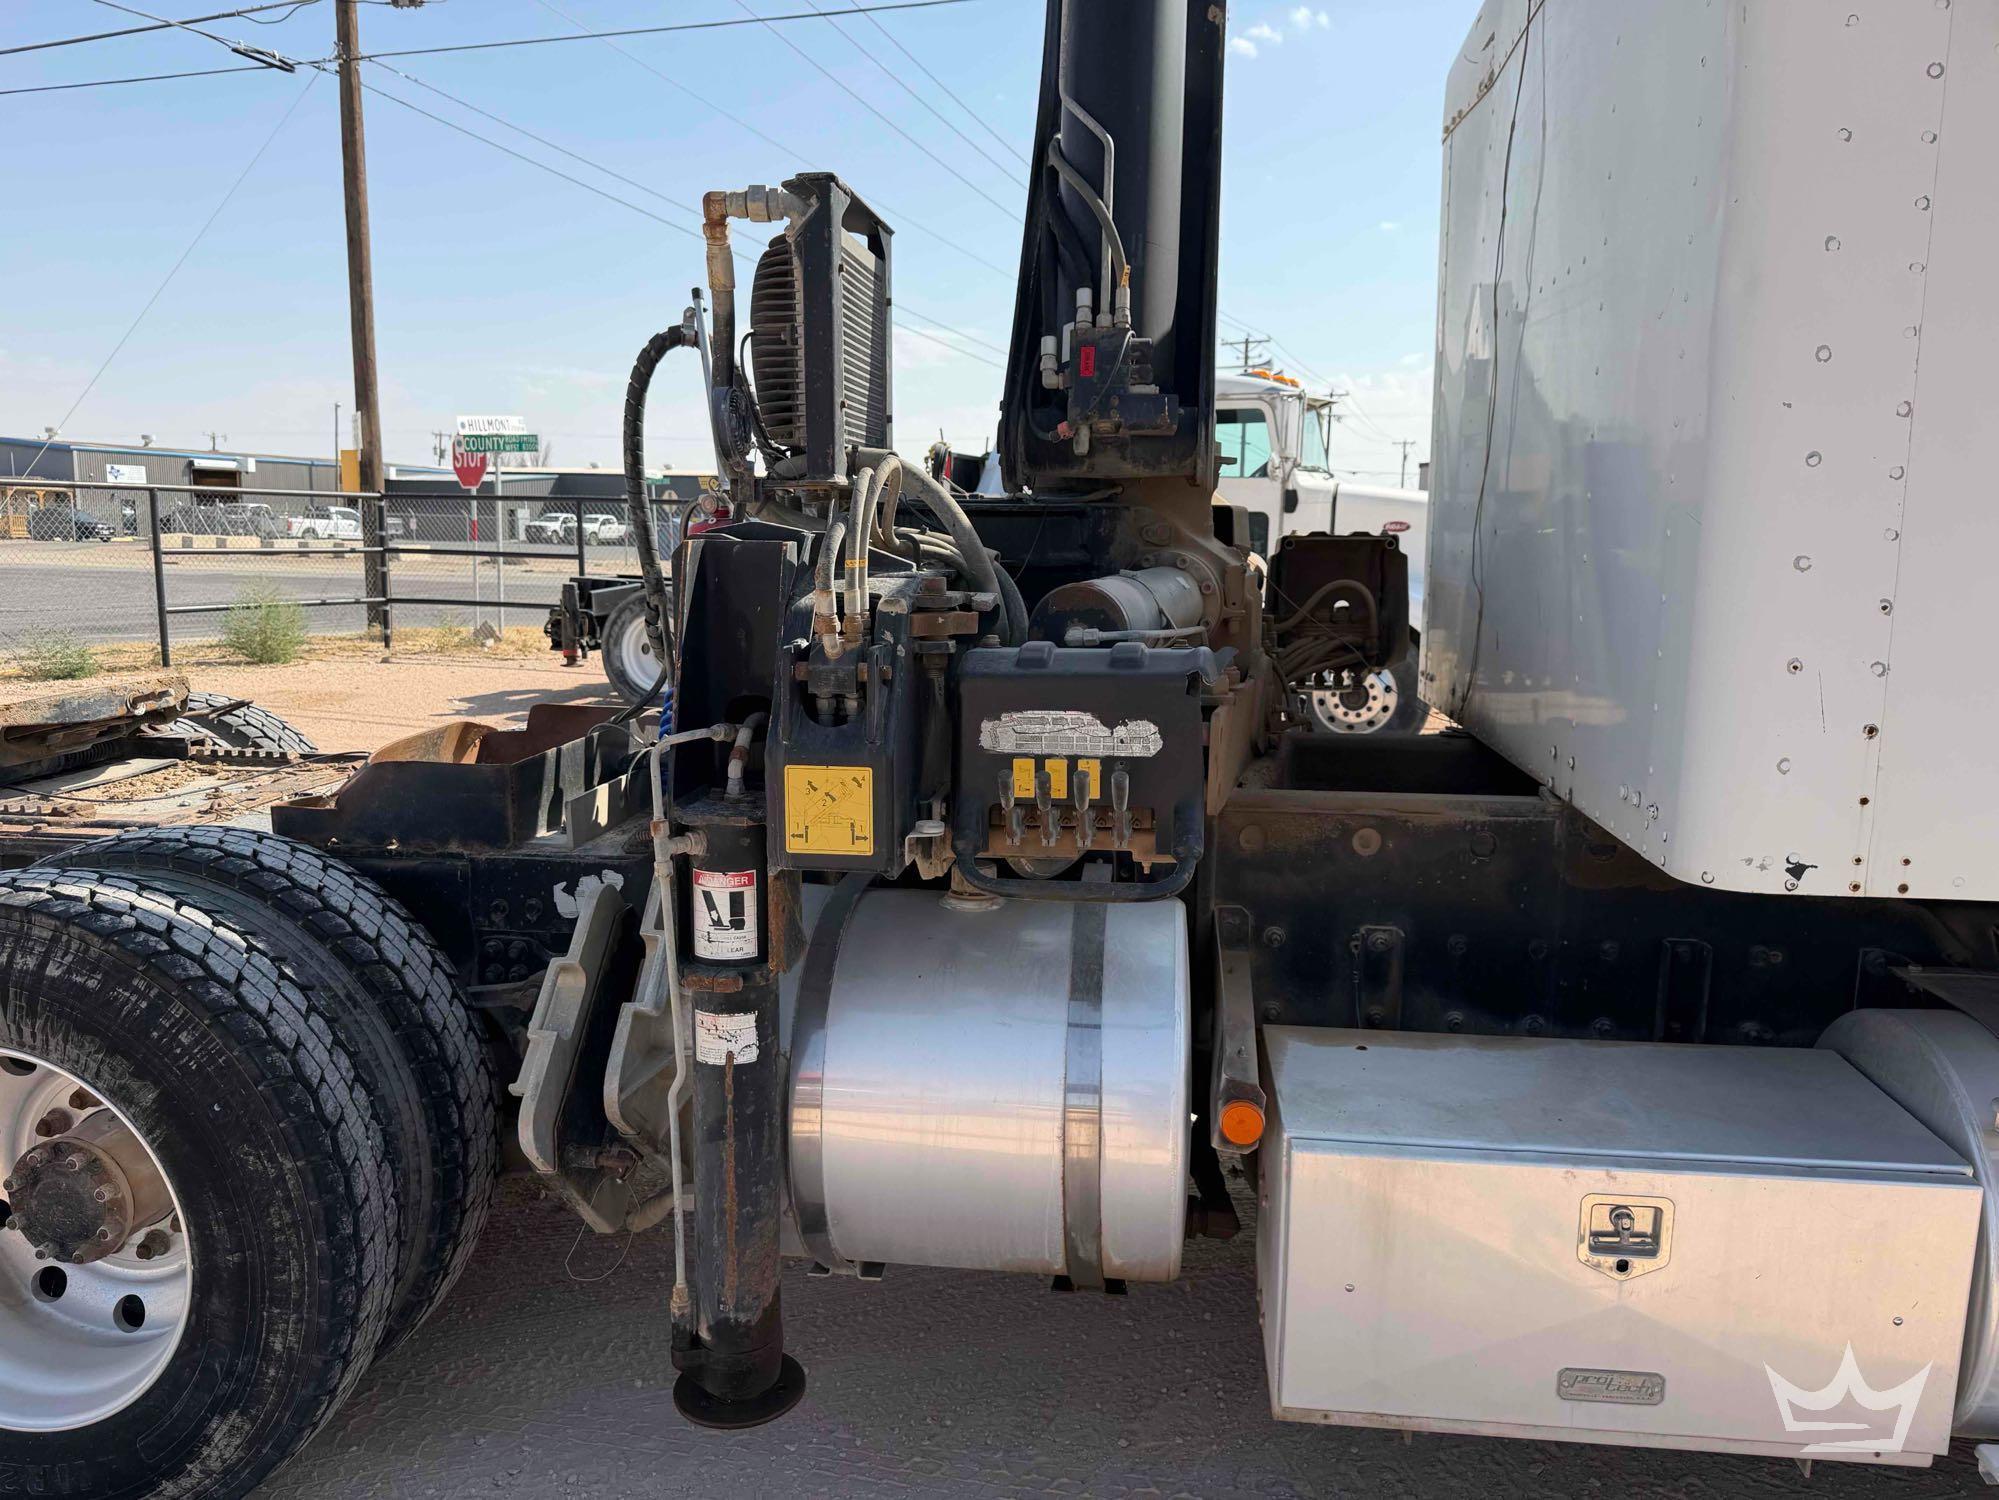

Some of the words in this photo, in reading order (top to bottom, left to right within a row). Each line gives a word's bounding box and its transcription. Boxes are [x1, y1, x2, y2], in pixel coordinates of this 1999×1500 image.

[467, 418, 511, 432] HILLMONT
[464, 436, 504, 451] COUNTY
[454, 451, 484, 468] STOP
[805, 788, 811, 796] 3
[821, 798, 828, 807] 2
[708, 874, 749, 886] DANGER
